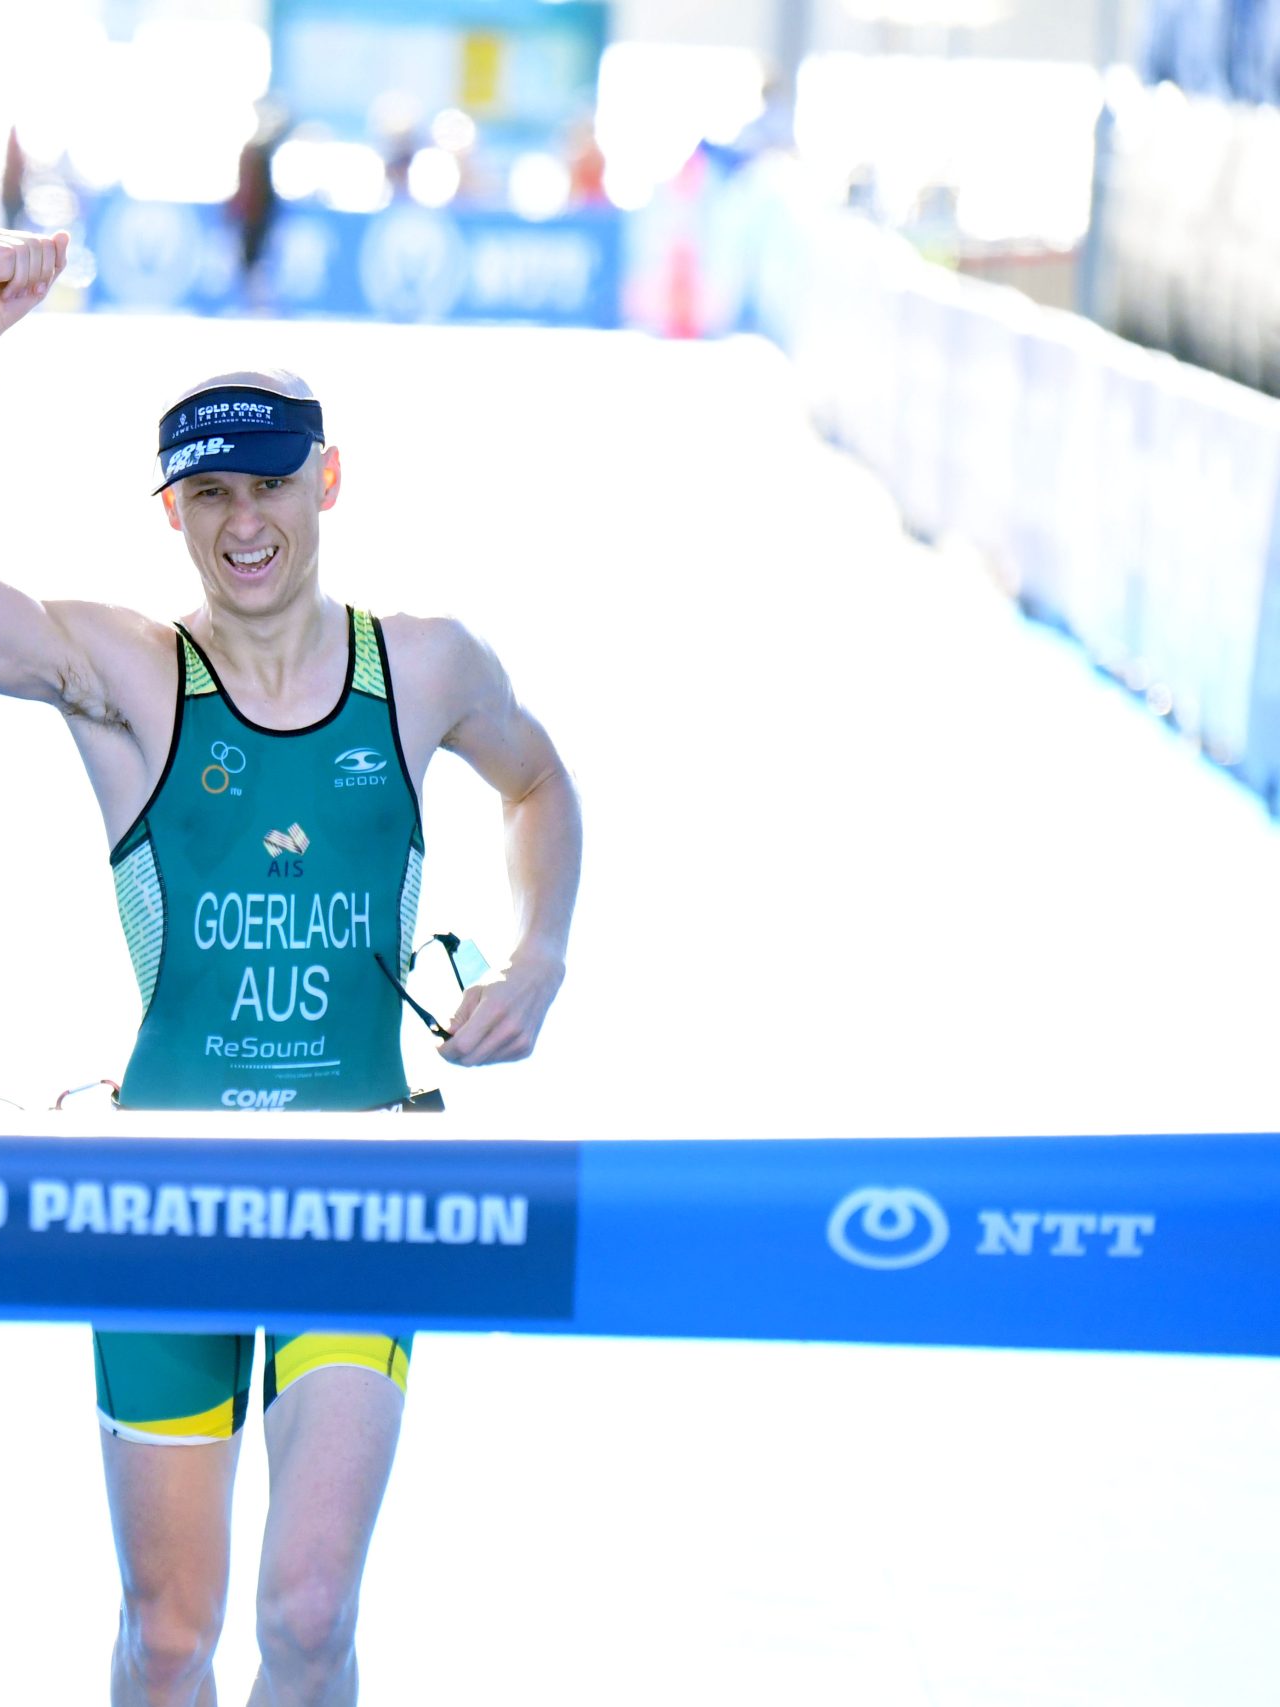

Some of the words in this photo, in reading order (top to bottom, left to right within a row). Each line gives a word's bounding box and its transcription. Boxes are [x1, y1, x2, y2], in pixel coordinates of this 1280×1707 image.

[198, 403, 229, 416] GOLD
[233, 402, 273, 415] COAST
[198, 411, 271, 422] TRIATHLON
[334, 775, 388, 788] SCODY
[267, 860, 304, 878] AIS
[193, 891, 371, 951] GOERLACH
[230, 964, 330, 1023] AUS
[205, 1035, 325, 1058] ReSound
[221, 1088, 297, 1108] COMP
[28, 1176, 529, 1245] PARATRIATHLON
[976, 1209, 1156, 1257] NTT
